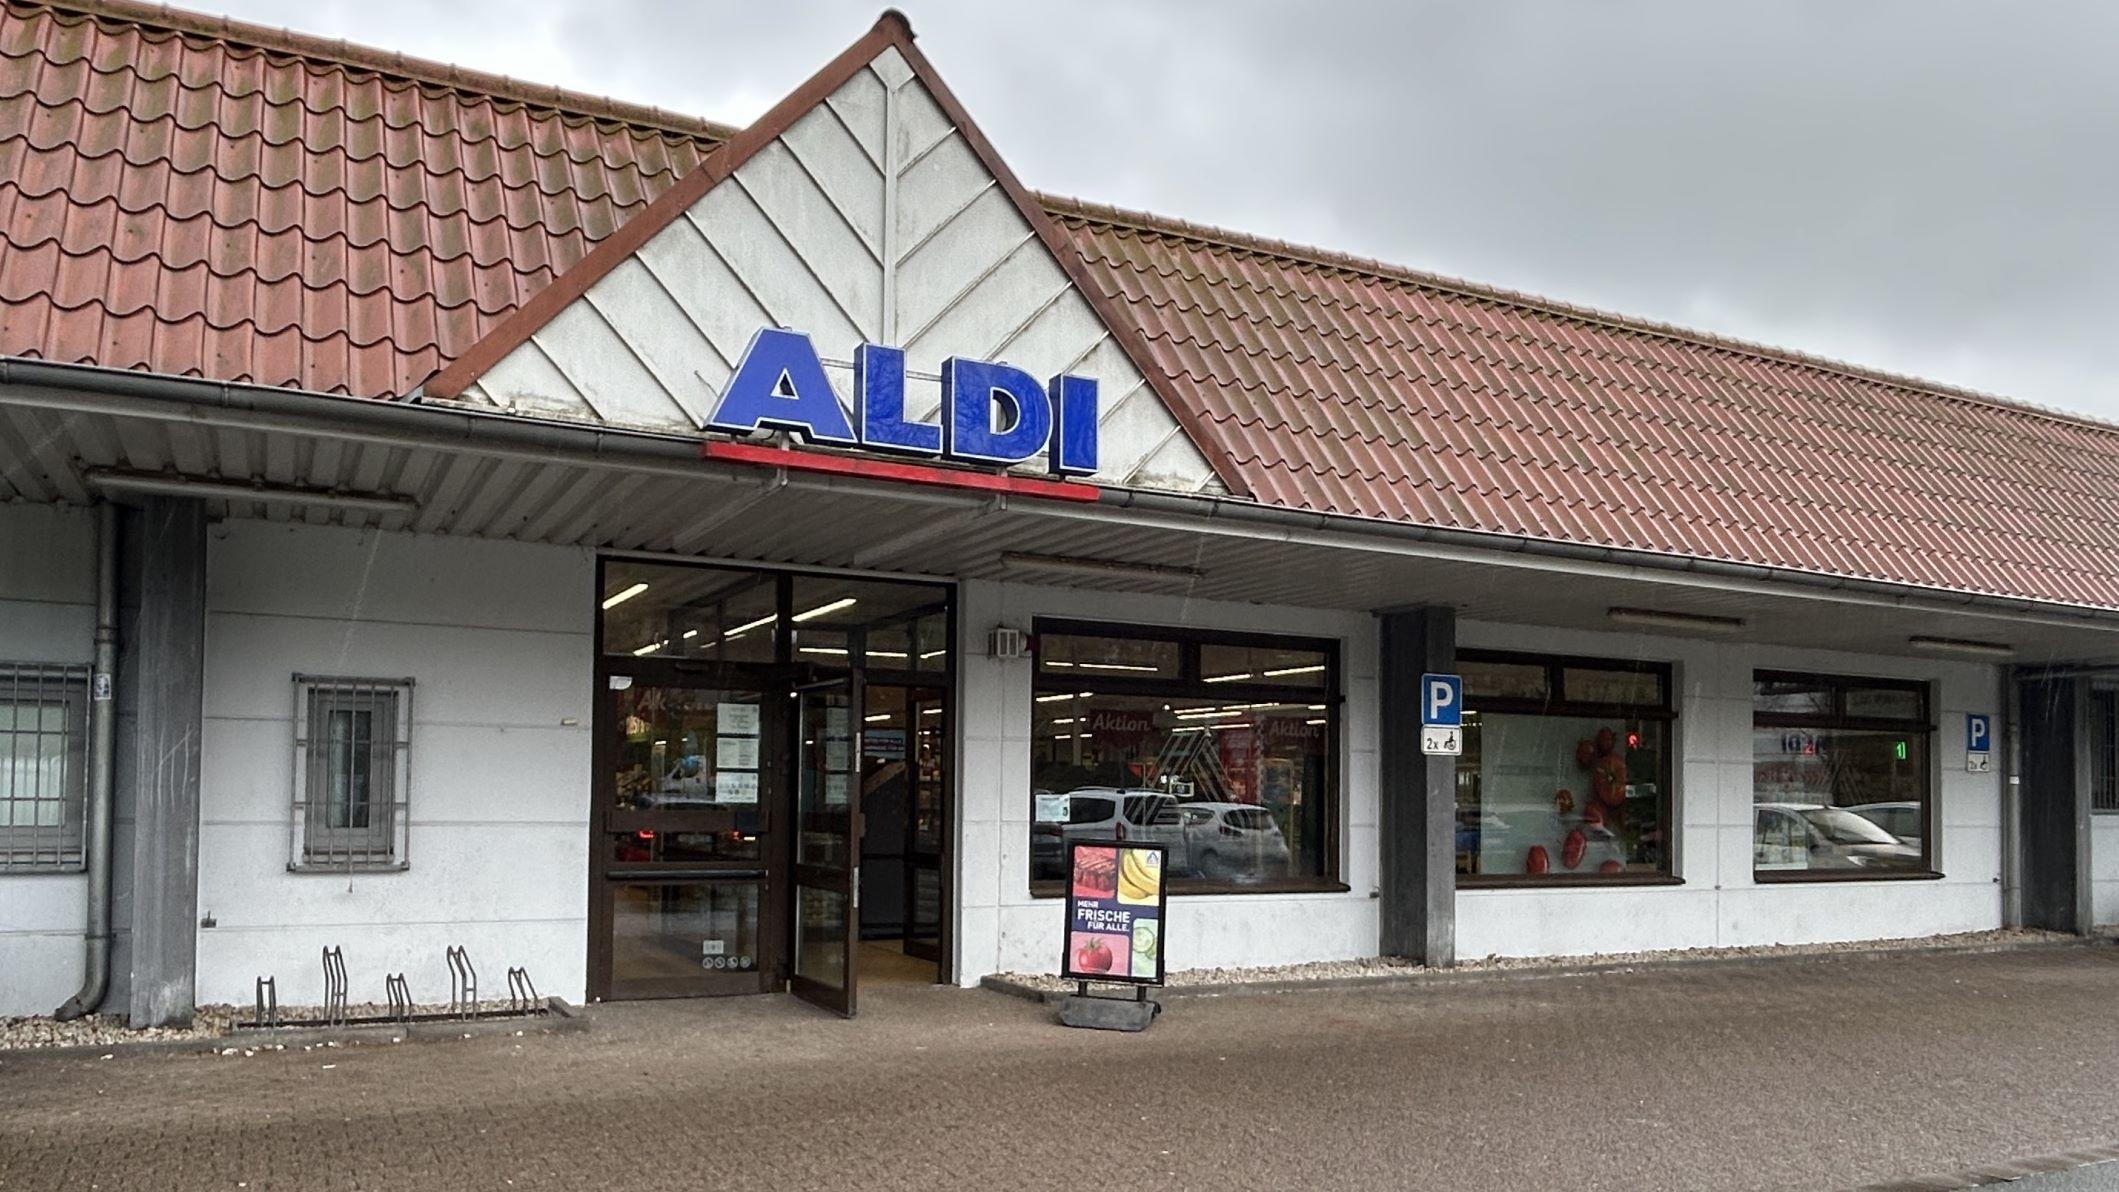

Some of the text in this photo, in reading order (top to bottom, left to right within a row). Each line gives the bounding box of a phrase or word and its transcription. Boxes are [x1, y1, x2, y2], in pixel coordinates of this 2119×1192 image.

[703, 326, 1099, 477] ALDI
[1430, 681, 1453, 720] P
[1093, 713, 1151, 731] Aktion
[1269, 720, 1319, 738] Aktion
[1971, 718, 1986, 747] P
[1077, 900, 1099, 908] MEHR
[1077, 908, 1131, 923] FRISCHE
